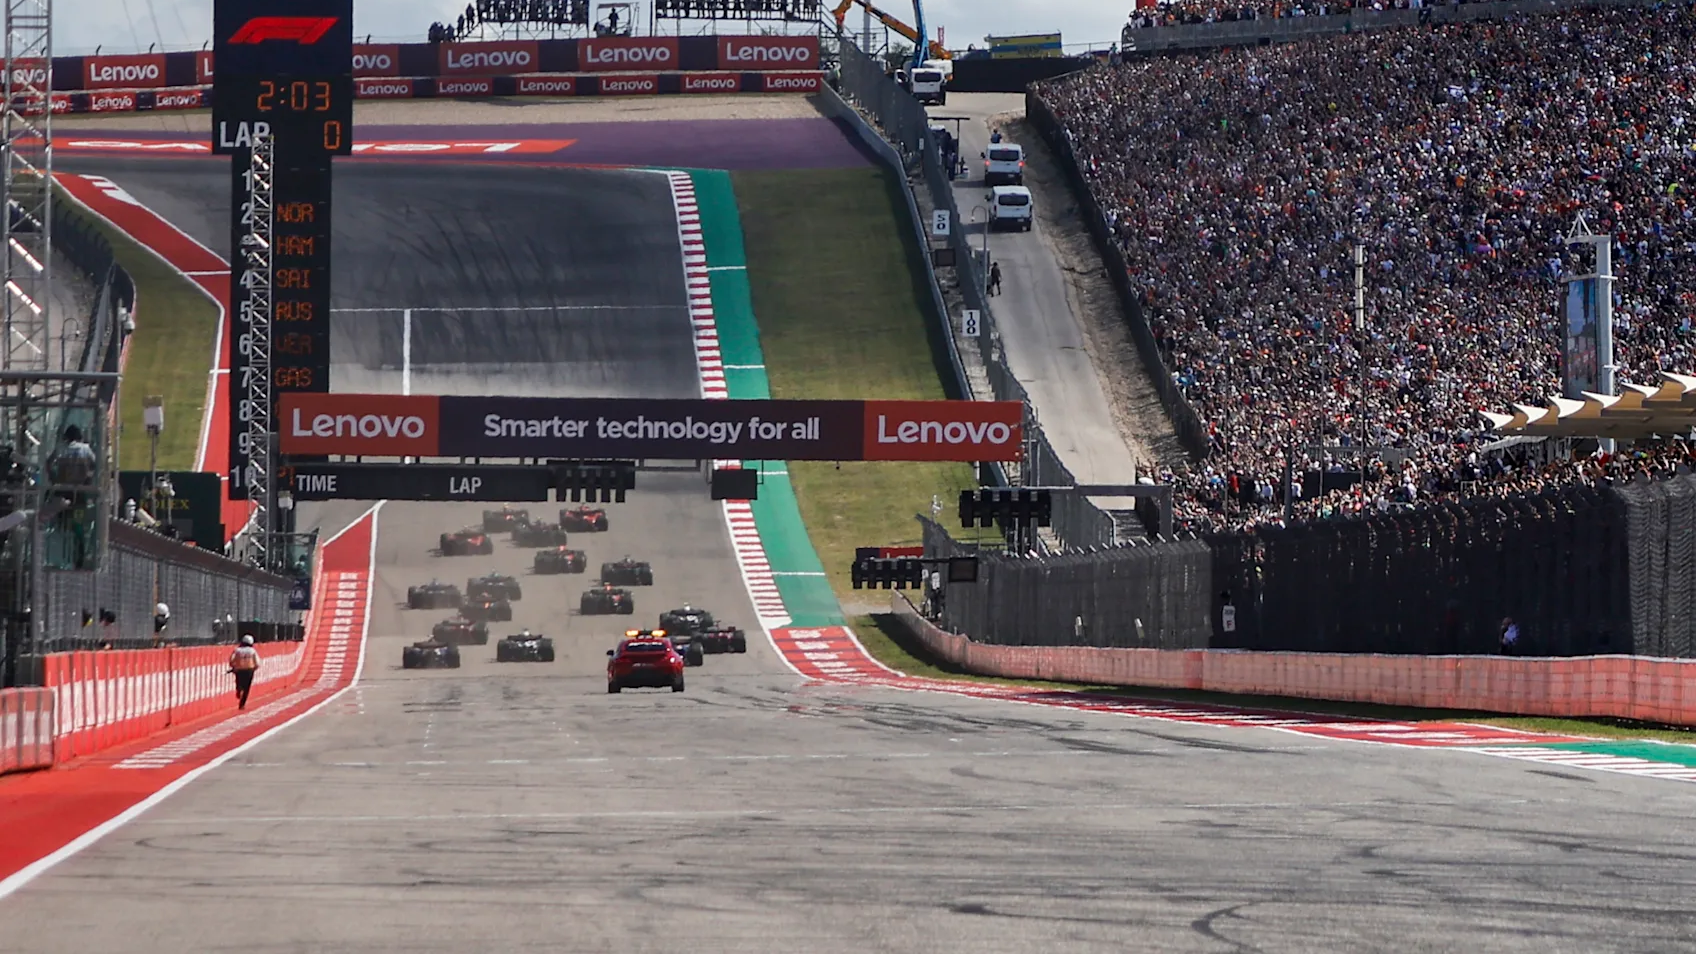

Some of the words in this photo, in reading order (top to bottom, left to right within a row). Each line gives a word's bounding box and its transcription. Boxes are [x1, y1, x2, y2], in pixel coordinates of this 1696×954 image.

[447, 49, 531, 69] Lenovo
[586, 44, 671, 63] Lenovo
[726, 42, 810, 62] Lenovo
[90, 63, 159, 82] Lenovo
[360, 83, 409, 95] Lenovo
[438, 80, 489, 93] Lenovo
[520, 79, 571, 92] Lenovo
[602, 79, 653, 91] Lenovo
[685, 77, 736, 89] Lenovo
[766, 77, 817, 89] Lenovo
[92, 95, 133, 110] Lenovo
[156, 95, 198, 106] Lenovo
[257, 81, 330, 111] 2:03
[220, 122, 271, 148] LAP
[324, 120, 341, 150] 0
[240, 203, 252, 225] 2
[276, 204, 314, 222] NOR
[937, 214, 946, 230] 50
[276, 236, 314, 255] HAM
[240, 269, 251, 290] 4
[276, 269, 311, 289] SAI
[240, 300, 251, 322] 5
[276, 302, 313, 321] RUS
[967, 311, 976, 334] 100
[239, 334, 251, 355] 6
[239, 366, 251, 388] 7
[275, 367, 312, 387] GAS
[238, 399, 251, 421] 8
[292, 407, 425, 438] Lenovo
[484, 413, 588, 438] Smarter
[597, 414, 743, 444] technology
[750, 416, 787, 441] for
[791, 417, 820, 440] all
[877, 415, 1010, 444] Lenovo
[238, 432, 251, 454] 9
[296, 474, 337, 492] TIME
[450, 476, 482, 494] LAP
